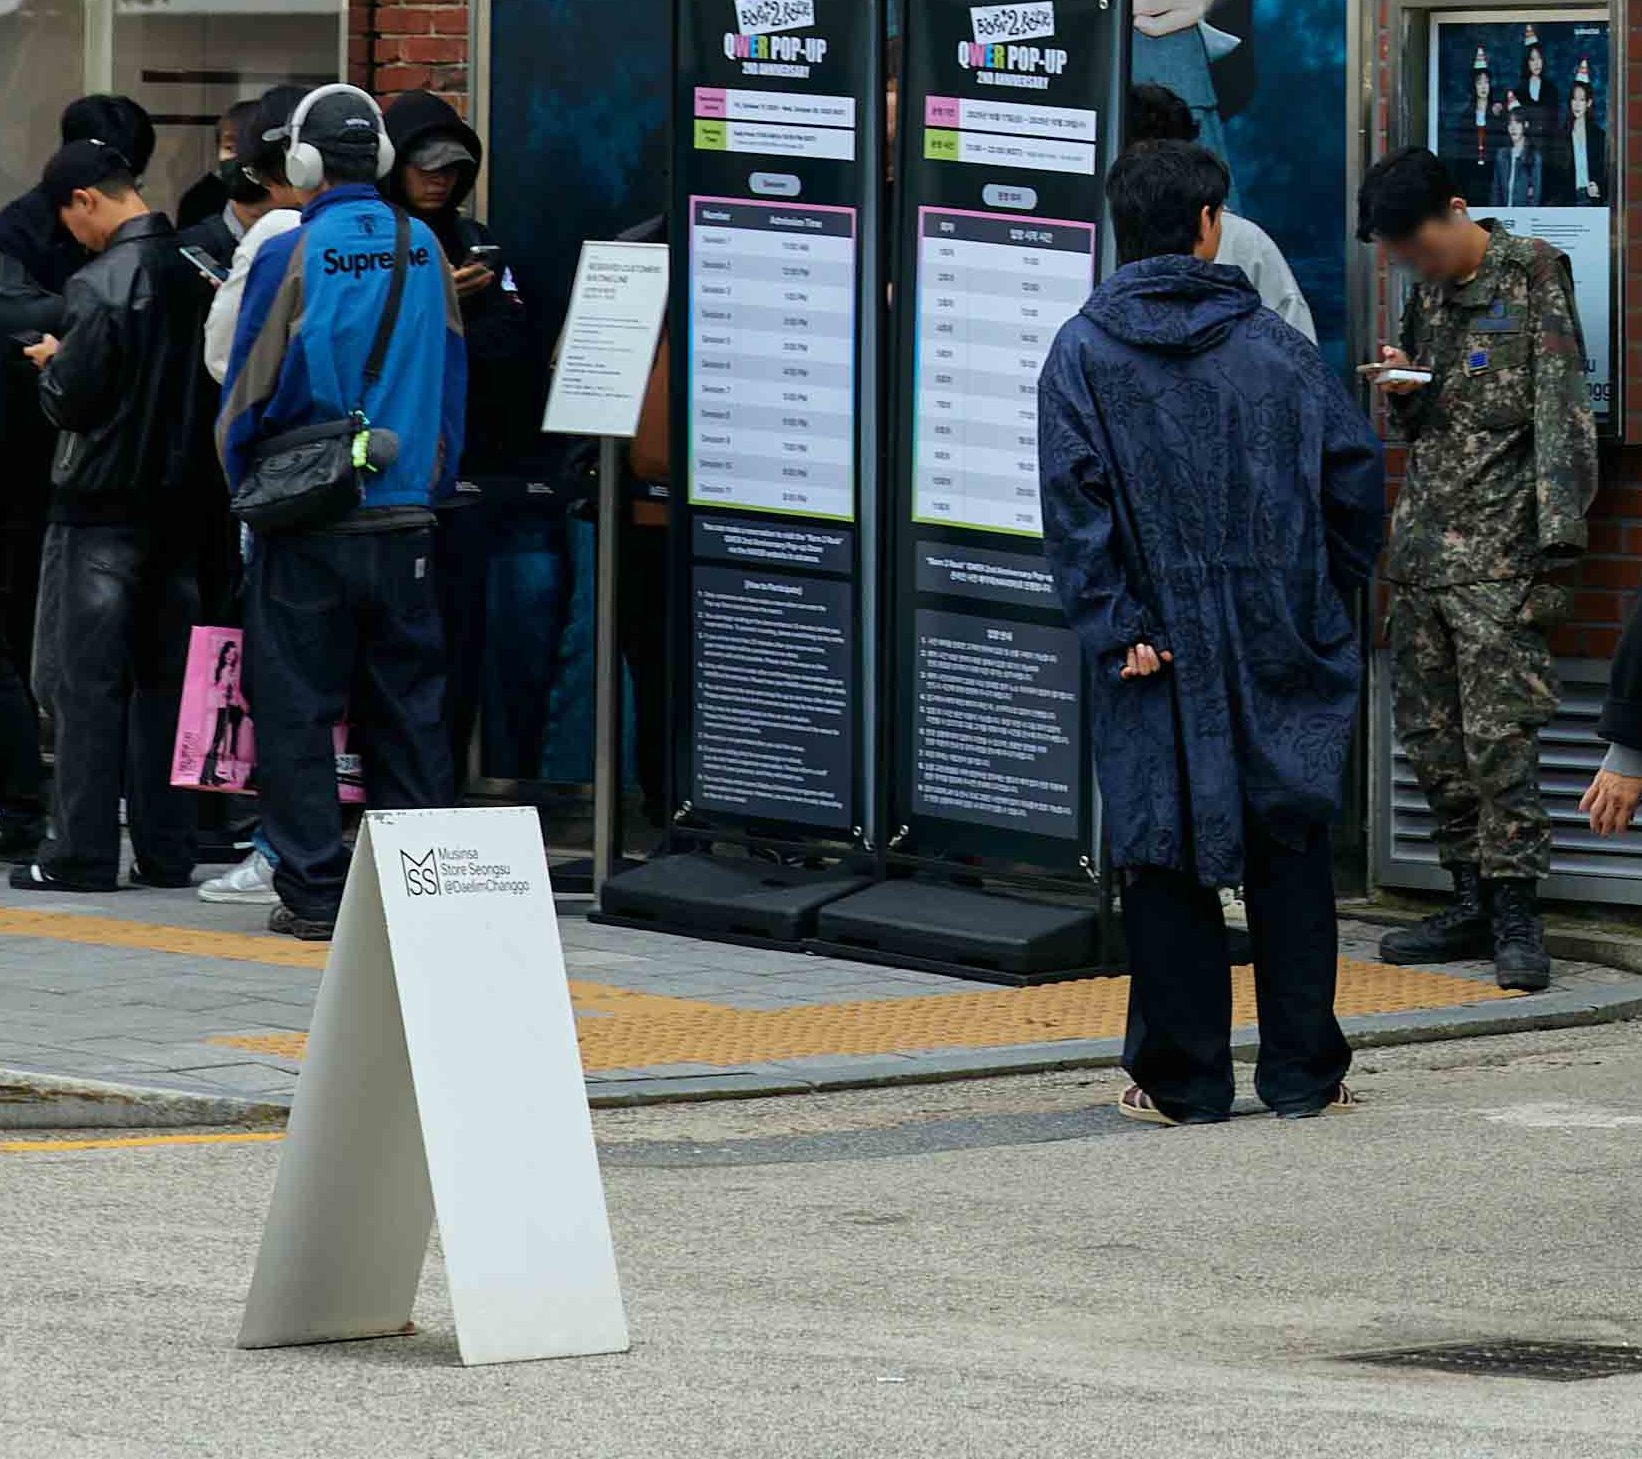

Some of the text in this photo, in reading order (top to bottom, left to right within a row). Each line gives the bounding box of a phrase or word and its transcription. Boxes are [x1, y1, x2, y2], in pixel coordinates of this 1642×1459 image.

[724, 32, 827, 63] QWER POP-UP
[958, 41, 1067, 74] QWER POP-UP
[438, 847, 479, 860] Musinsa
[441, 862, 511, 878] Store Seongsu
[444, 879, 530, 897] @DaelimChanggo
